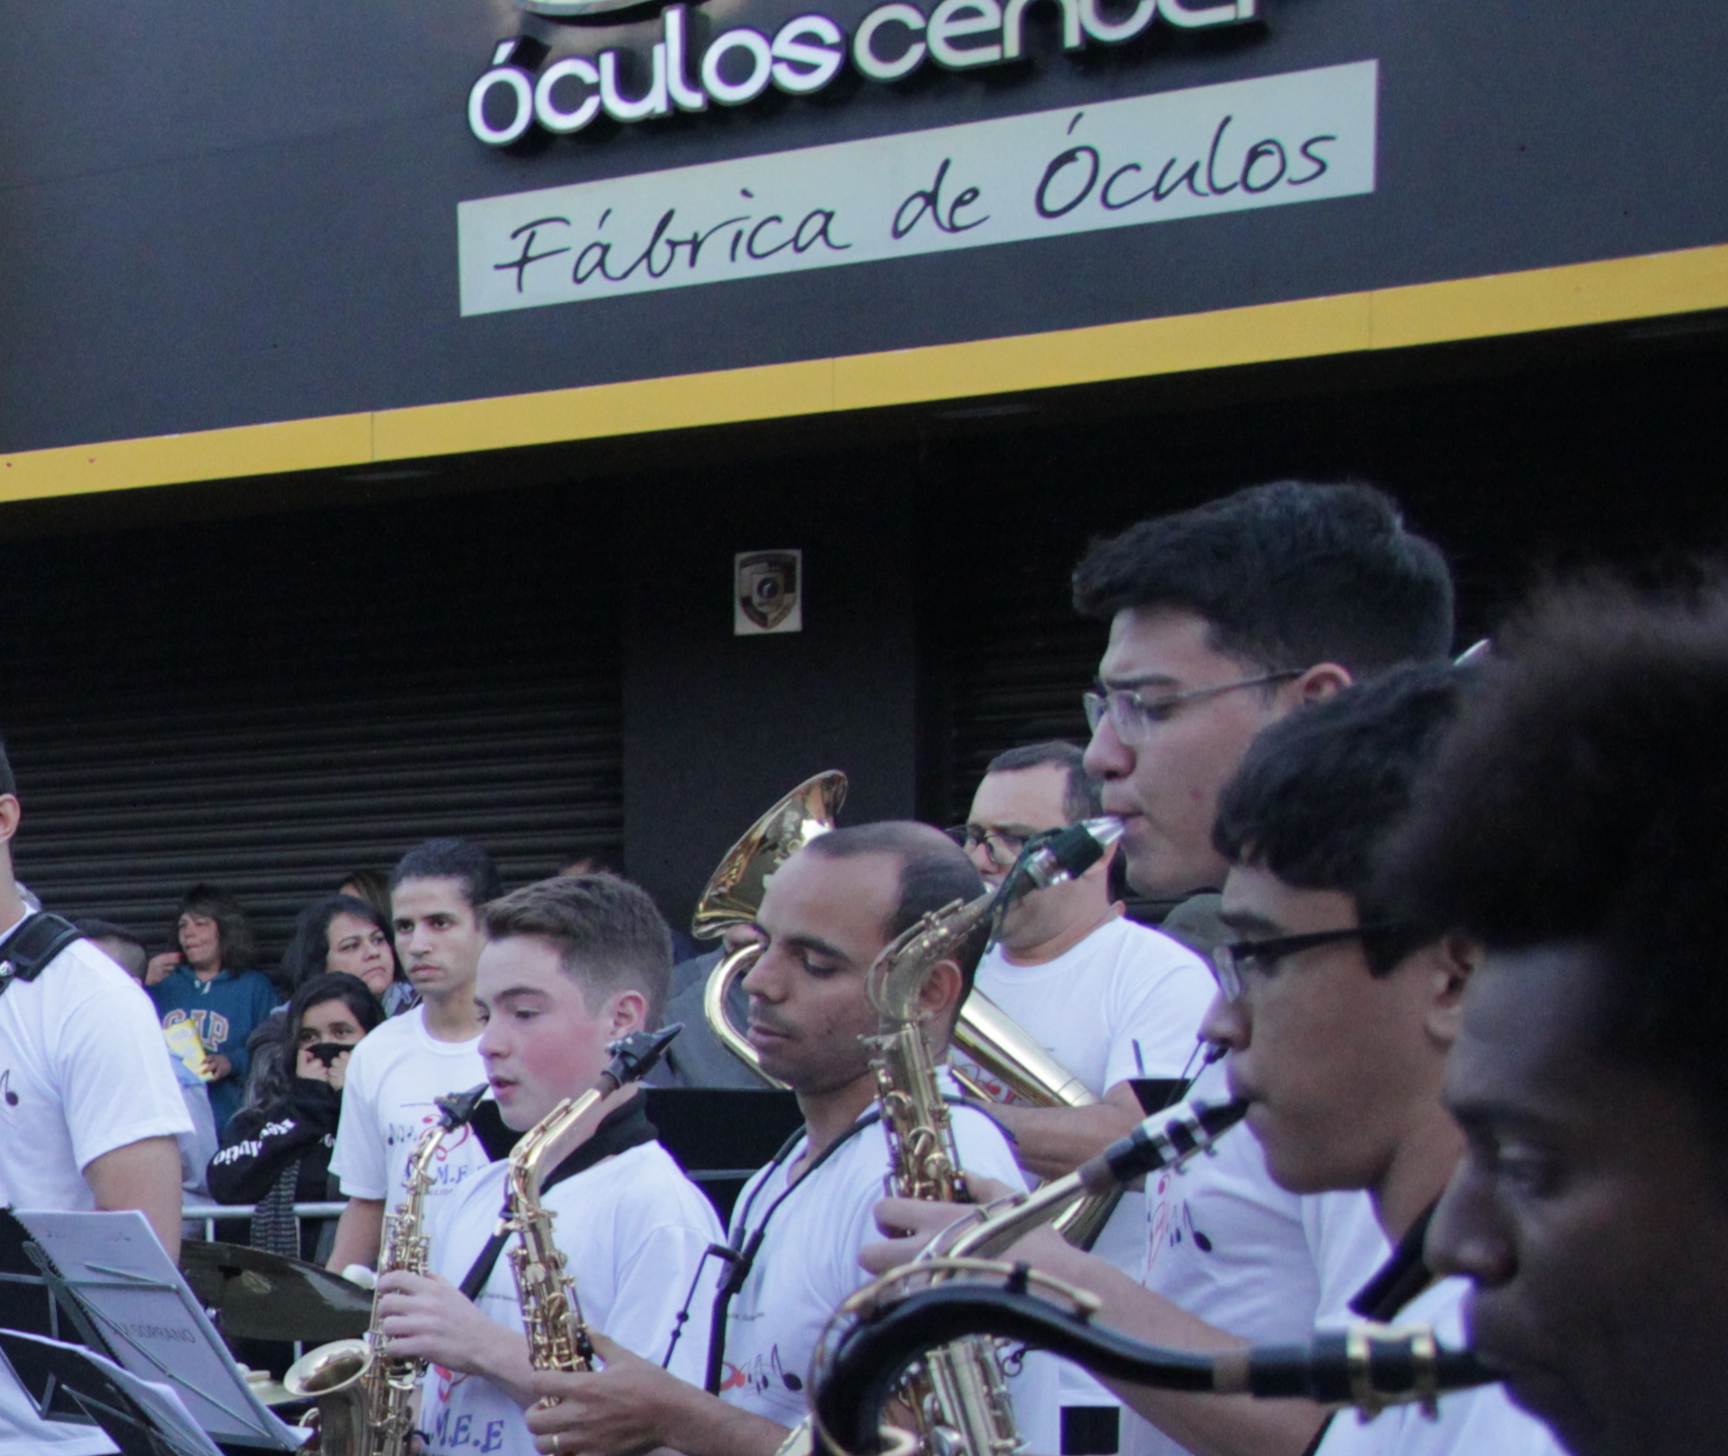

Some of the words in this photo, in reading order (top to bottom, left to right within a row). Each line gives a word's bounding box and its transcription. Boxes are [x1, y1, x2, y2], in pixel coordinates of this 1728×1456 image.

[492, 188, 852, 293] Fábrica
[891, 159, 990, 238] de
[1034, 113, 1337, 219] Óculos
